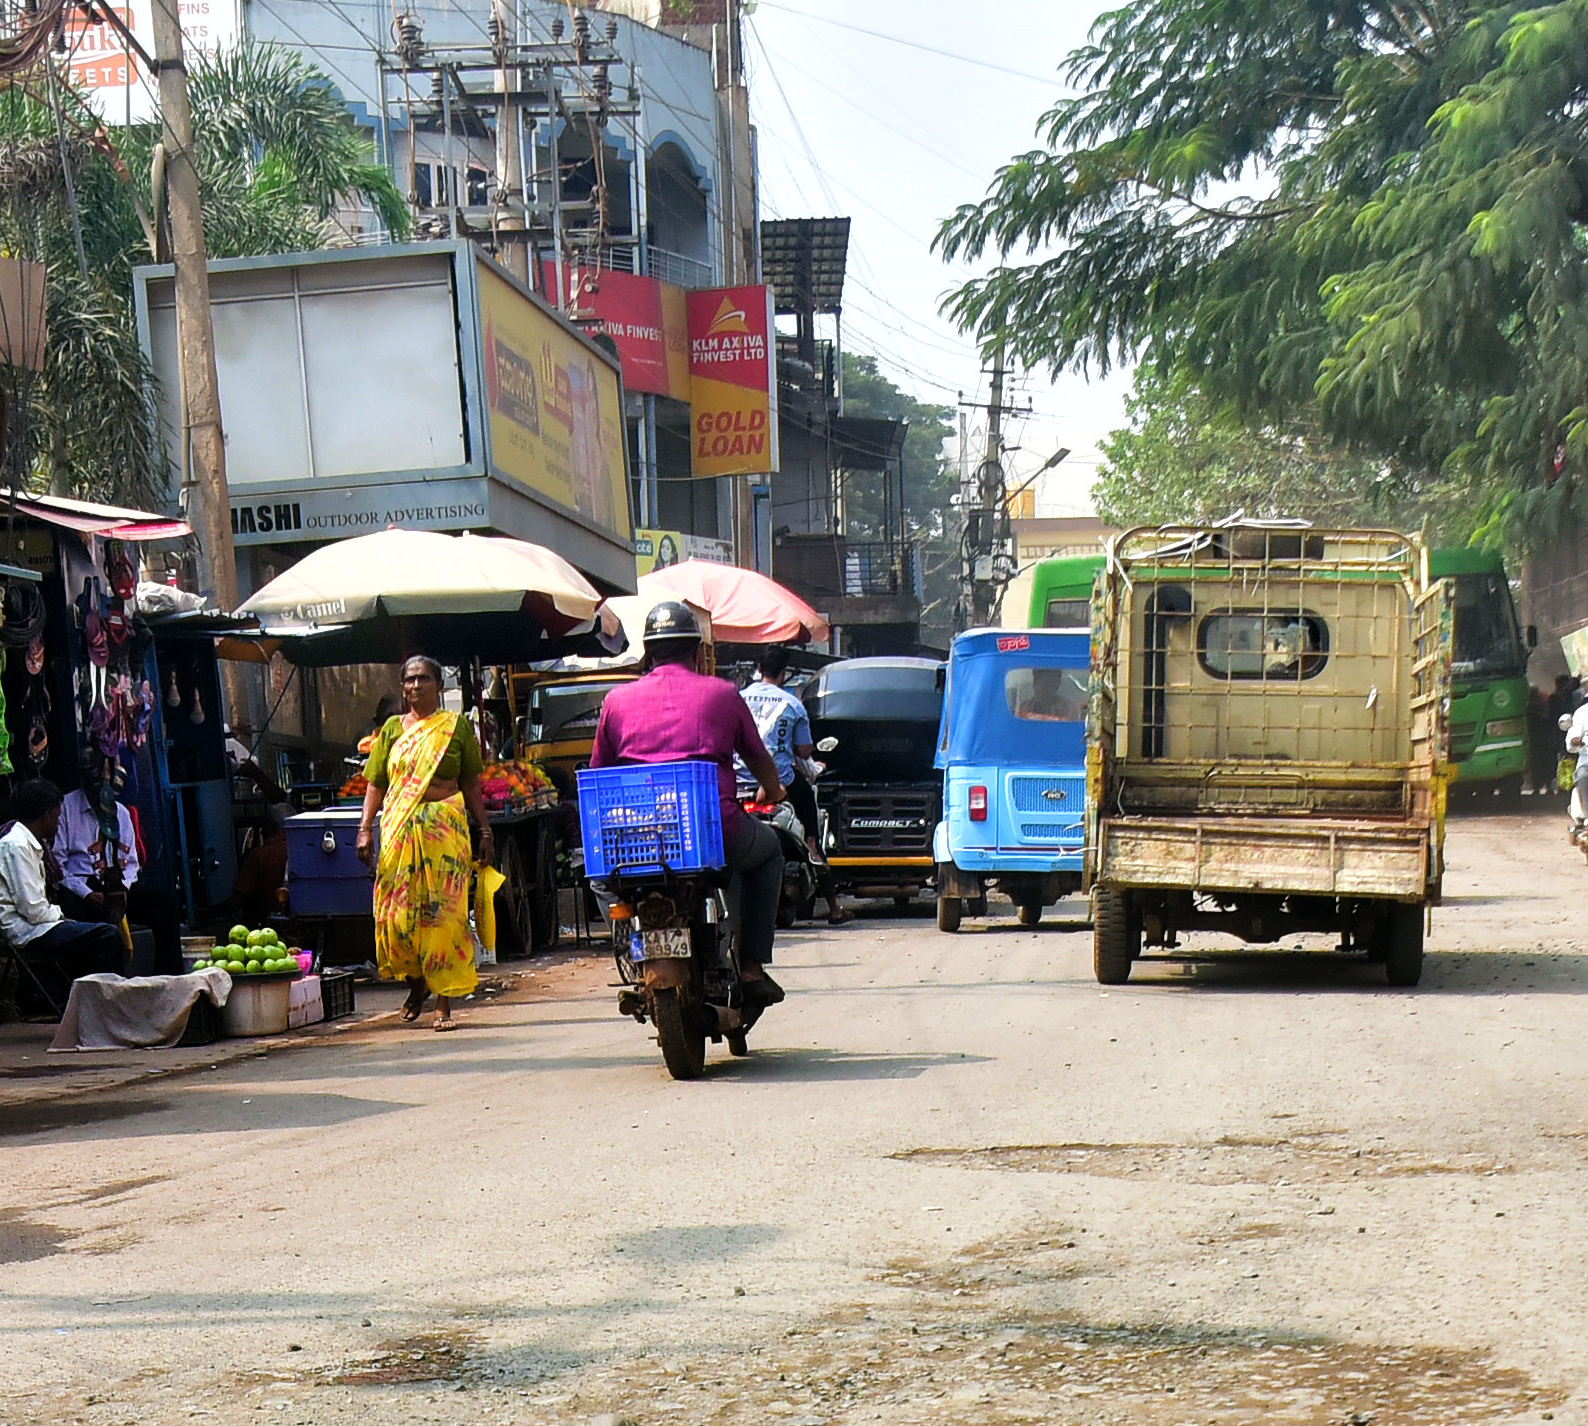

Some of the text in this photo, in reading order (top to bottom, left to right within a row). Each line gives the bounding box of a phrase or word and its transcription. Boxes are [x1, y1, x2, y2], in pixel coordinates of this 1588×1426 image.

[692, 337, 718, 351] KLM
[693, 347, 765, 364] FINVEST LTD
[696, 408, 766, 435] GOLD
[697, 434, 765, 459] LOAN
[305, 513, 380, 530] OUTDOOR
[383, 503, 486, 524] ADVERTISING
[296, 597, 346, 619] Camel
